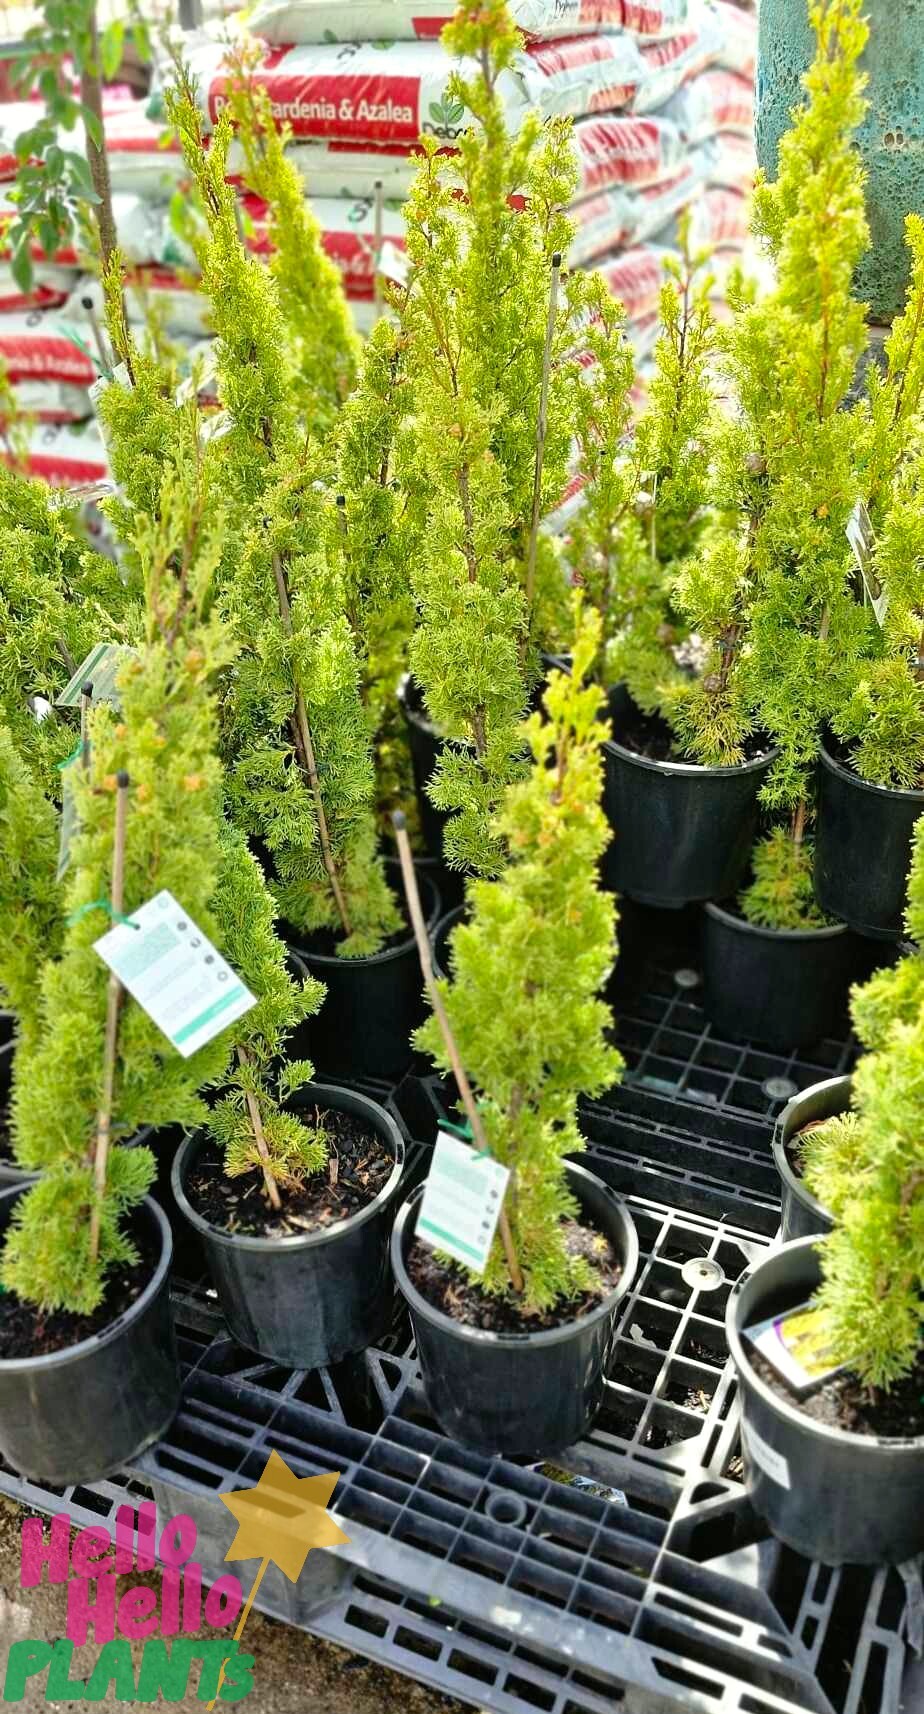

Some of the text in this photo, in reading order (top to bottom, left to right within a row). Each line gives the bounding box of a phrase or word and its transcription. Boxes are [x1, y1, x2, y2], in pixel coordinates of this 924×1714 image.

[266, 97, 336, 120] ardenia
[339, 98, 354, 121] &
[356, 98, 413, 124] Azalea
